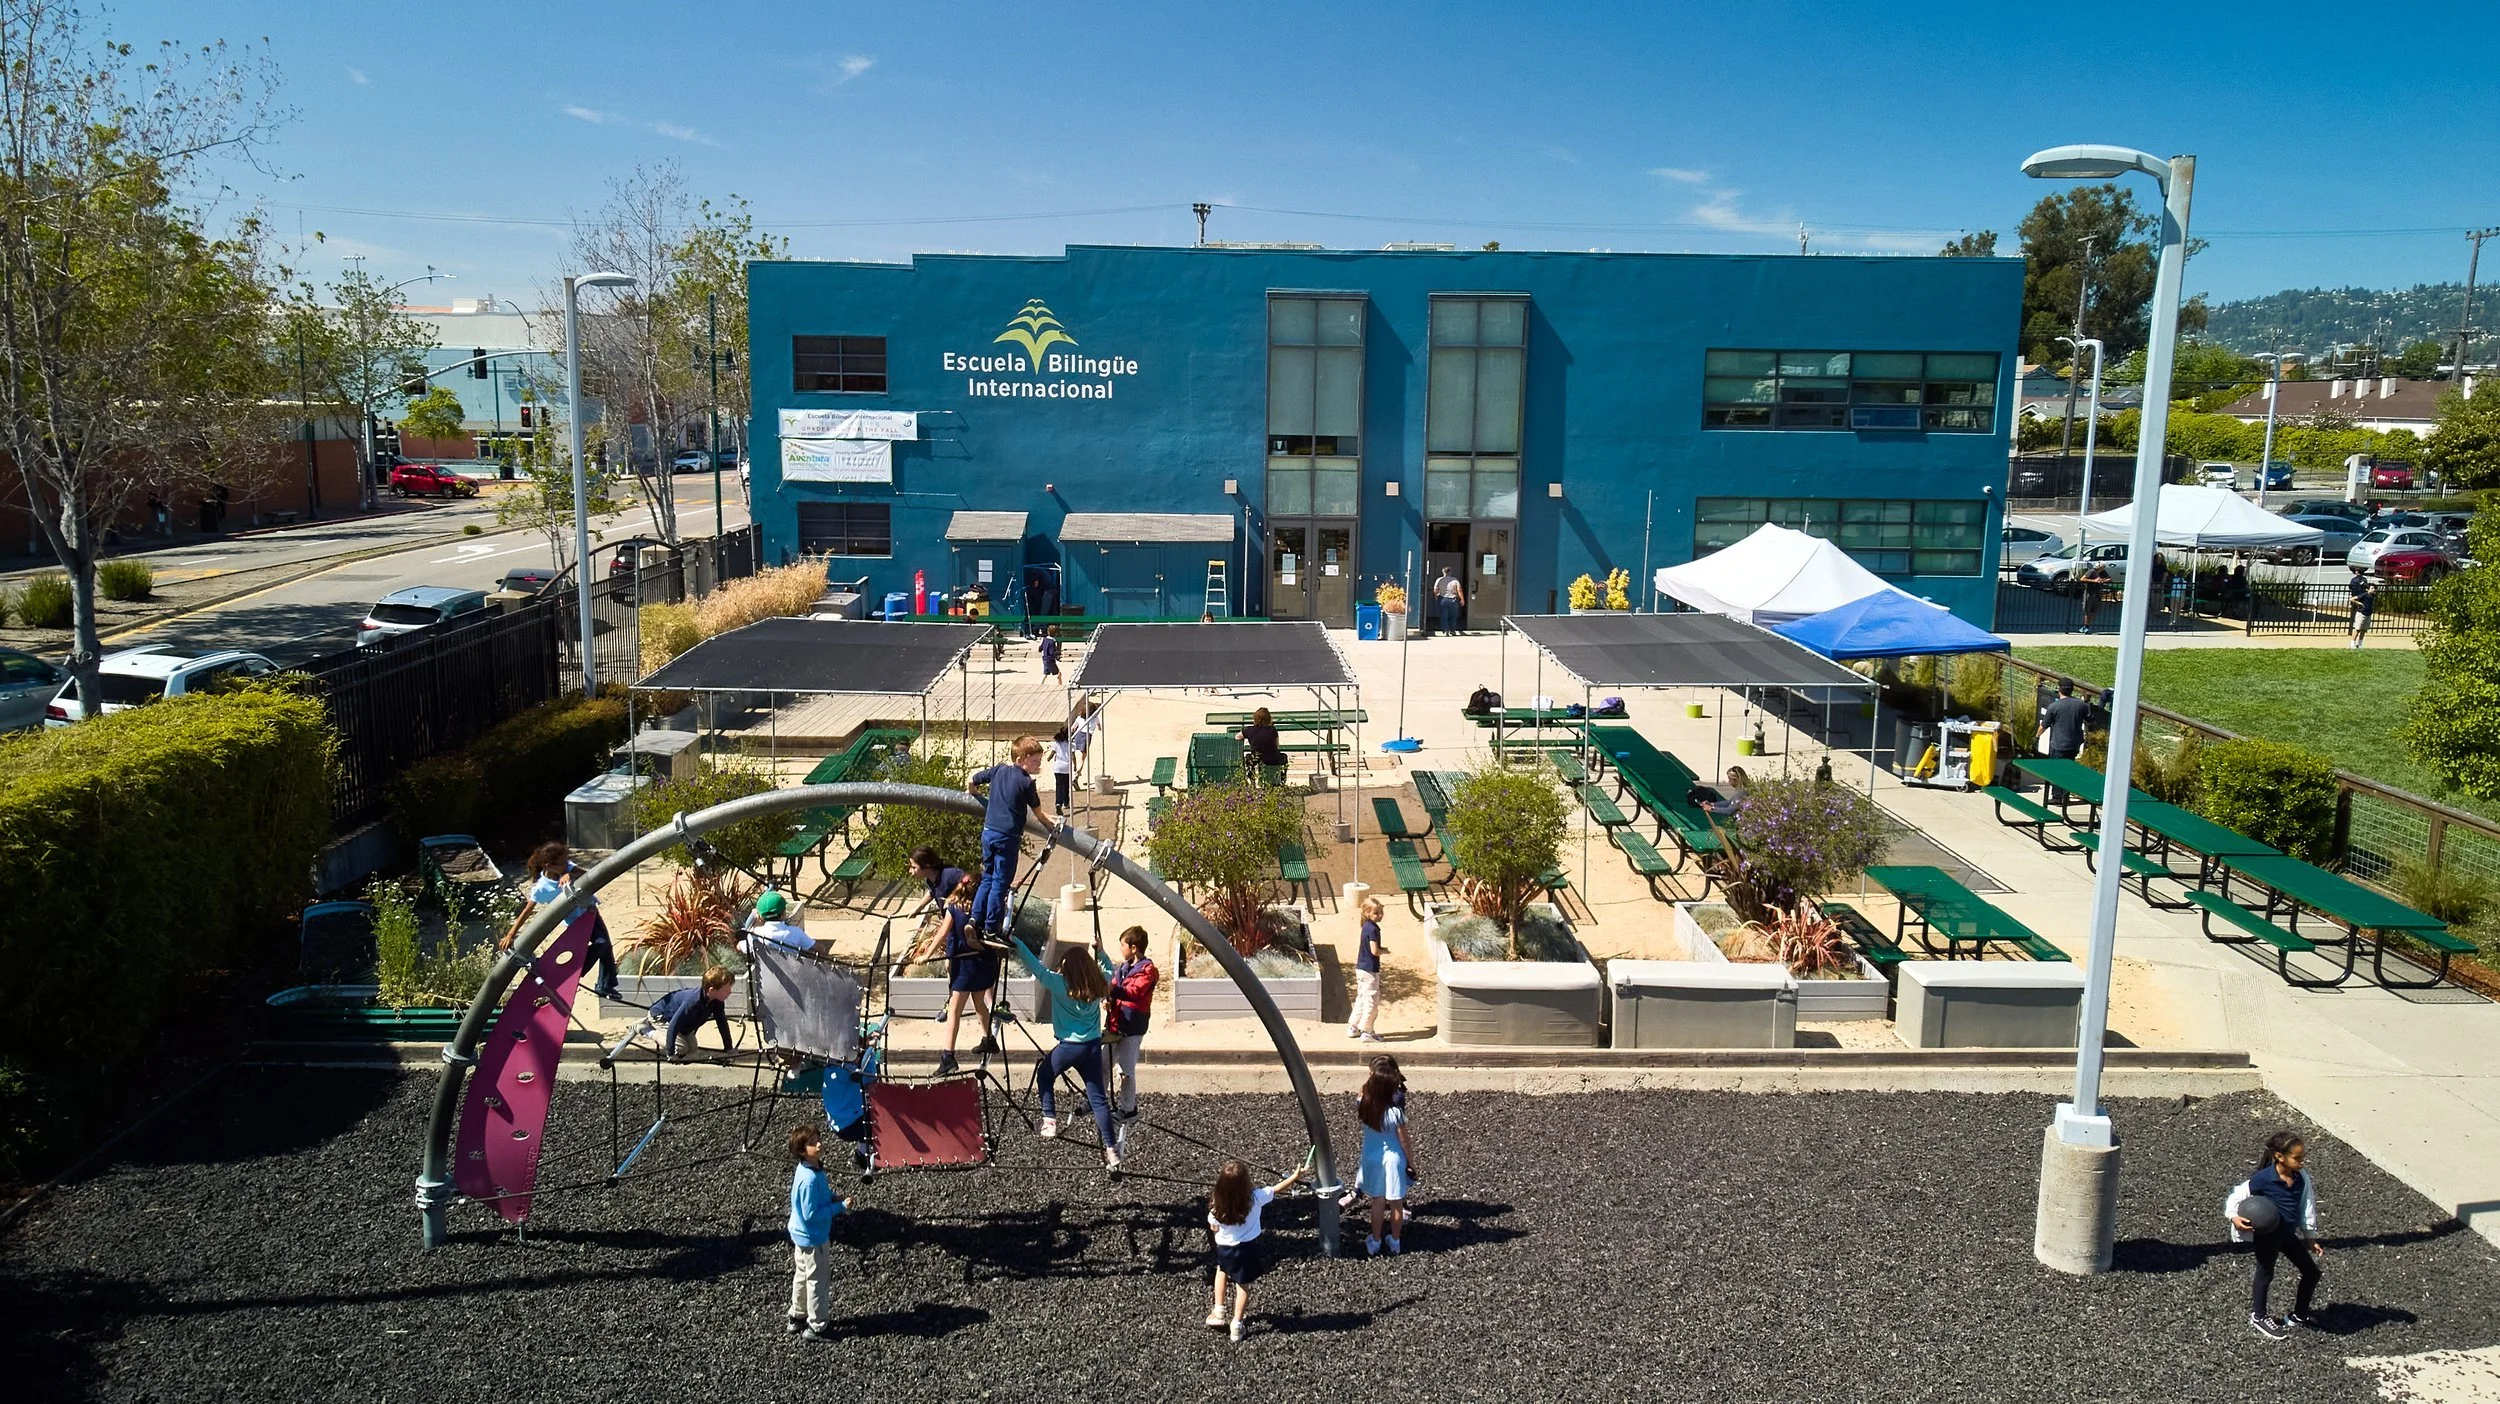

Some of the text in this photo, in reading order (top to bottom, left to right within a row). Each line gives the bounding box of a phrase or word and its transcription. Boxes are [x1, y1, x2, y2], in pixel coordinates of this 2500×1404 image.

[943, 352, 1139, 377] Escuela Bilingüe
[969, 378, 1113, 399] Internacional
[788, 454, 830, 463] Aventura
